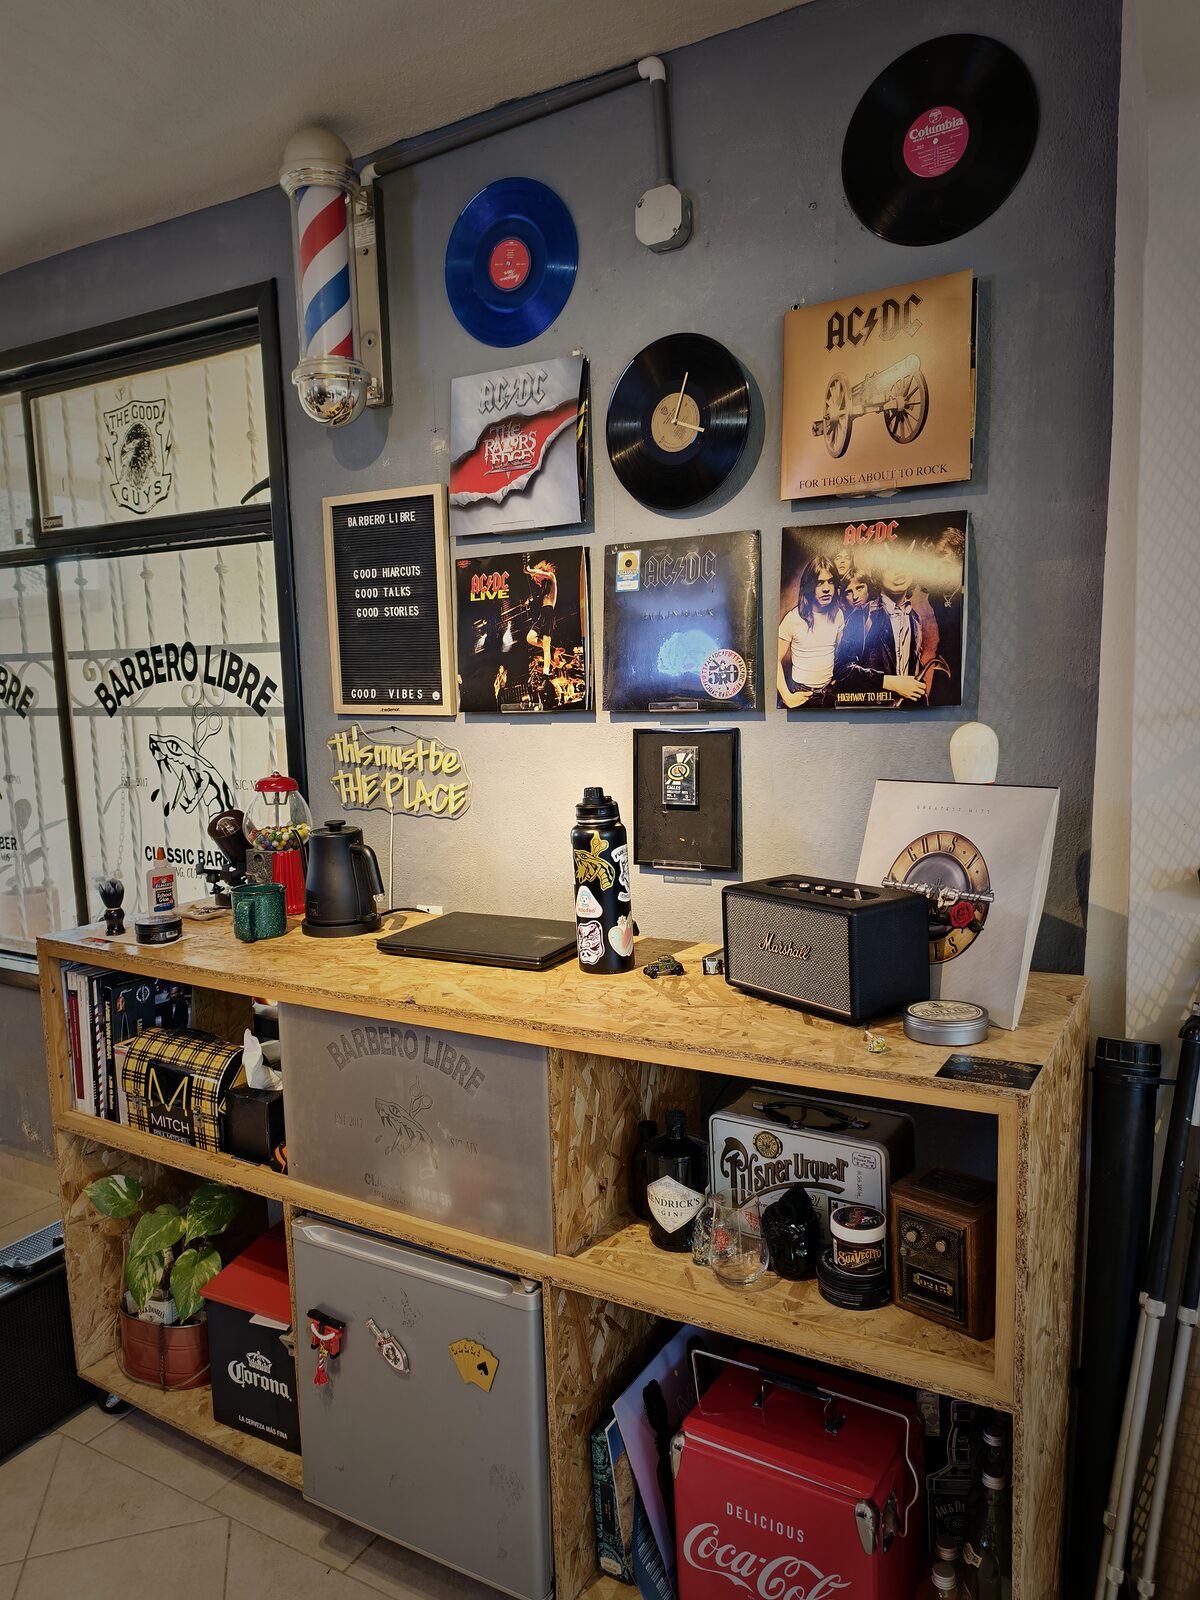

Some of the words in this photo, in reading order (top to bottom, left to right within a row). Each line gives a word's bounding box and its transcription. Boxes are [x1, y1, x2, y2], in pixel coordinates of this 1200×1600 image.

[909, 117, 964, 140] Columbia
[108, 408, 130, 430] THE
[131, 404, 161, 420] GOOD
[799, 479, 820, 489] FOR
[820, 474, 856, 488] THOSE
[858, 469, 897, 484] ABOUT
[899, 468, 914, 479] TO
[915, 463, 948, 477] ROCK
[121, 480, 163, 505] GUYS
[347, 514, 385, 527] BARBERO
[389, 511, 416, 524] LIBRE
[353, 568, 377, 579] GOOD
[354, 588, 378, 599] GOOD
[383, 586, 411, 597] TALKS
[470, 589, 510, 602] LIVE
[356, 607, 379, 618] GOOD
[94, 641, 198, 718] BARBERO
[203, 645, 278, 717] LIBRE
[351, 688, 377, 699] GOOD
[388, 689, 423, 699] VIBES
[837, 692, 867, 702] HIGHWAY
[867, 692, 876, 701] TO
[876, 691, 894, 701] HELL
[373, 739, 429, 773] must
[428, 740, 461, 774] be
[380, 771, 469, 814] PLACE
[906, 833, 959, 862] GUNS
[757, 931, 812, 961] Marshall
[326, 1026, 419, 1072] BARBERO
[423, 1035, 486, 1097] LIBRE
[150, 1112, 190, 1135] MITCH
[720, 1136, 792, 1209] Pilsner
[793, 1152, 849, 1183] Urquell
[660, 1210, 679, 1218] GIN
[227, 1360, 291, 1400] Corona
[245, 1418, 265, 1430] CERVEZA
[726, 1501, 805, 1543] DELICIOUS
[683, 1522, 852, 1600] Coca-Col
